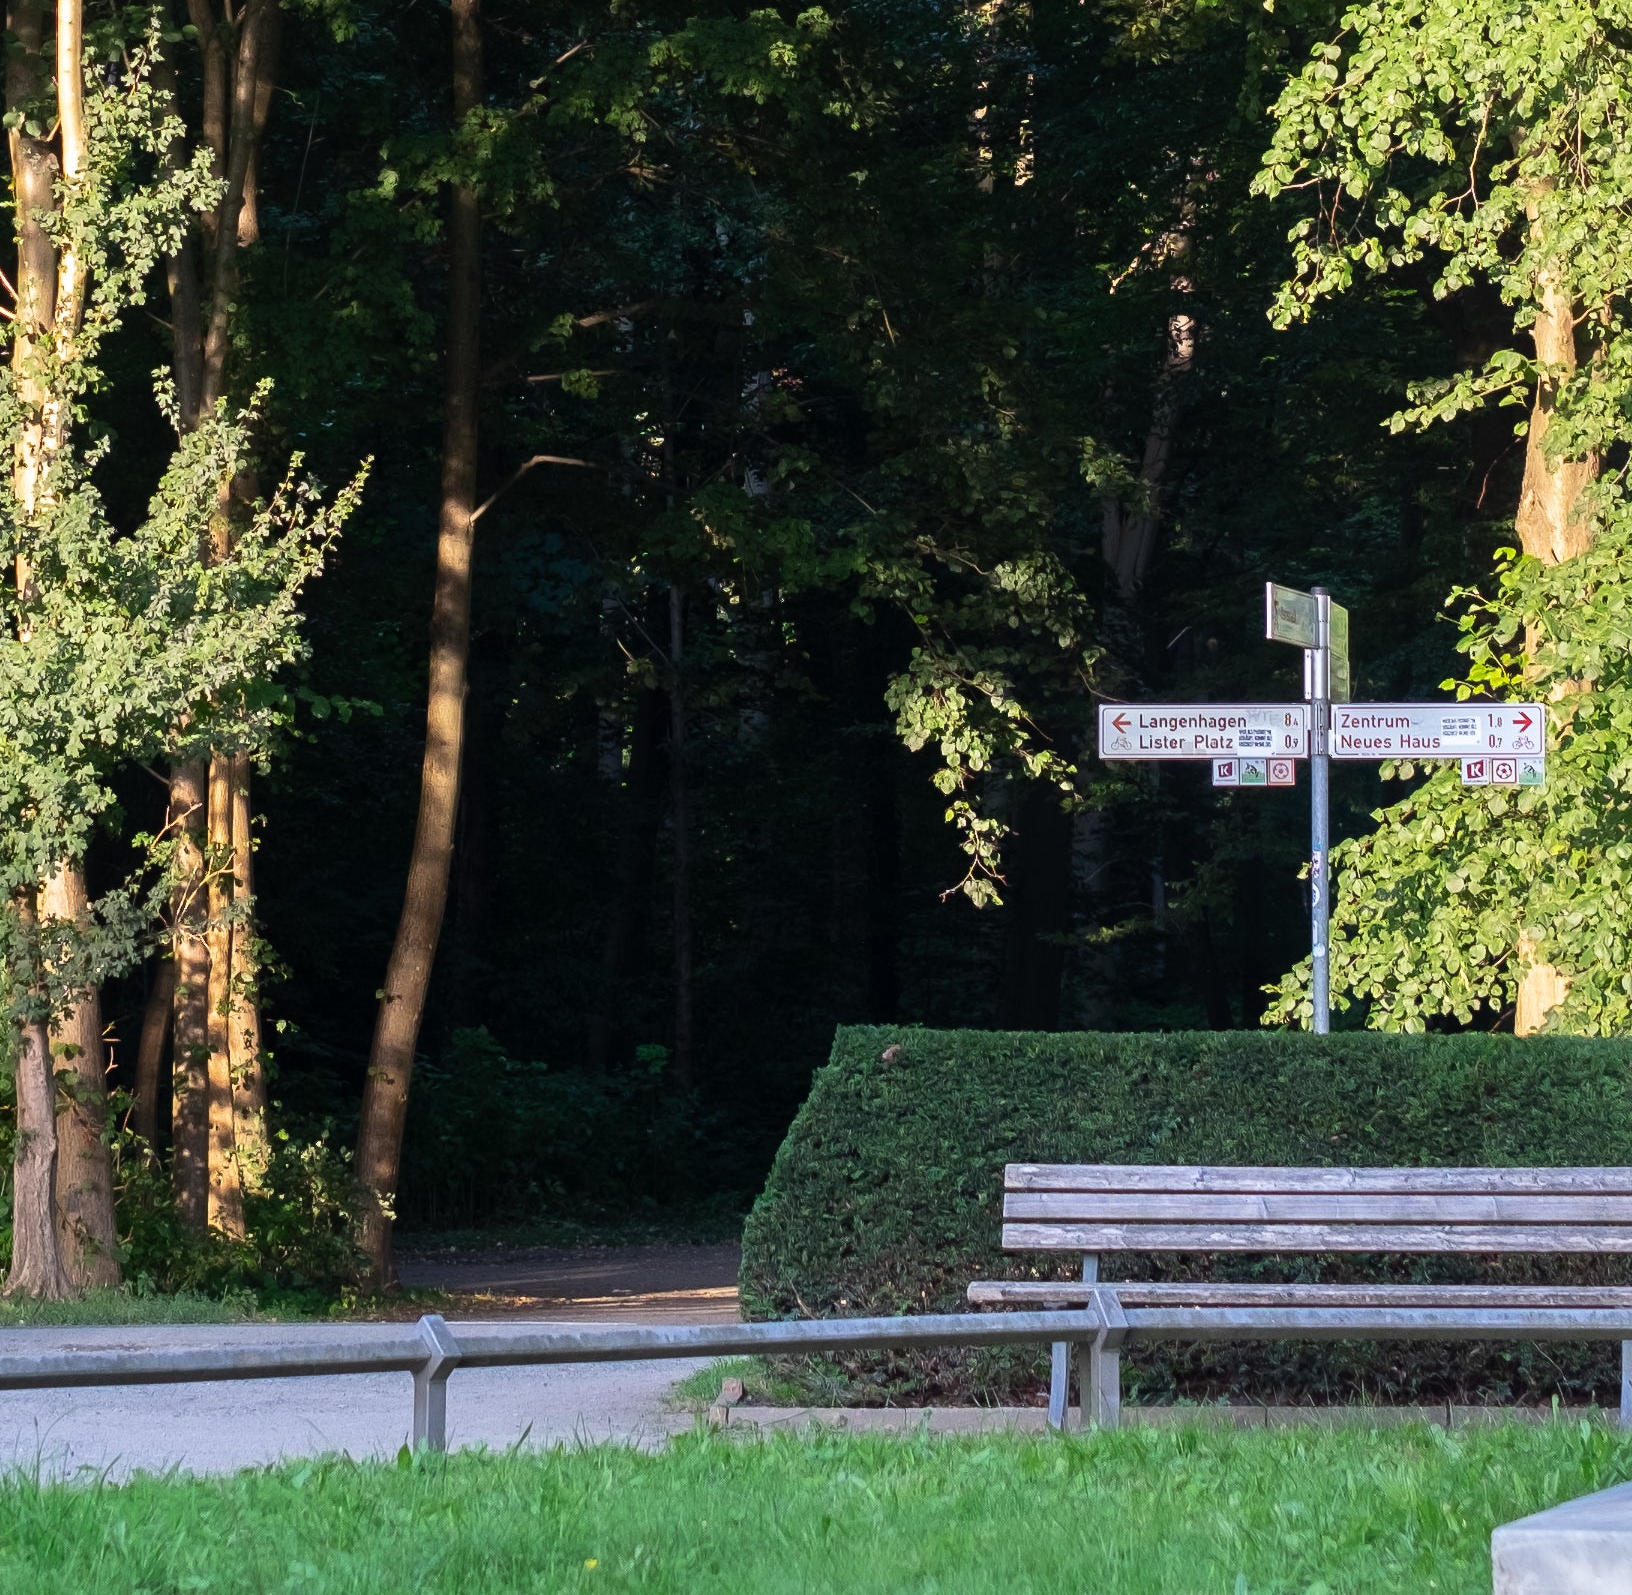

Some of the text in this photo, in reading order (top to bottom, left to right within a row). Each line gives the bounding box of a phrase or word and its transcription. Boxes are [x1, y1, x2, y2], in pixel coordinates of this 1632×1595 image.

[1140, 714, 1247, 731] Langenhagen
[1341, 714, 1410, 728] Zentrum
[1140, 735, 1186, 749] Lister
[1194, 735, 1233, 749] Platz
[1341, 735, 1392, 749] Neues
[1400, 735, 1441, 749] Haus
